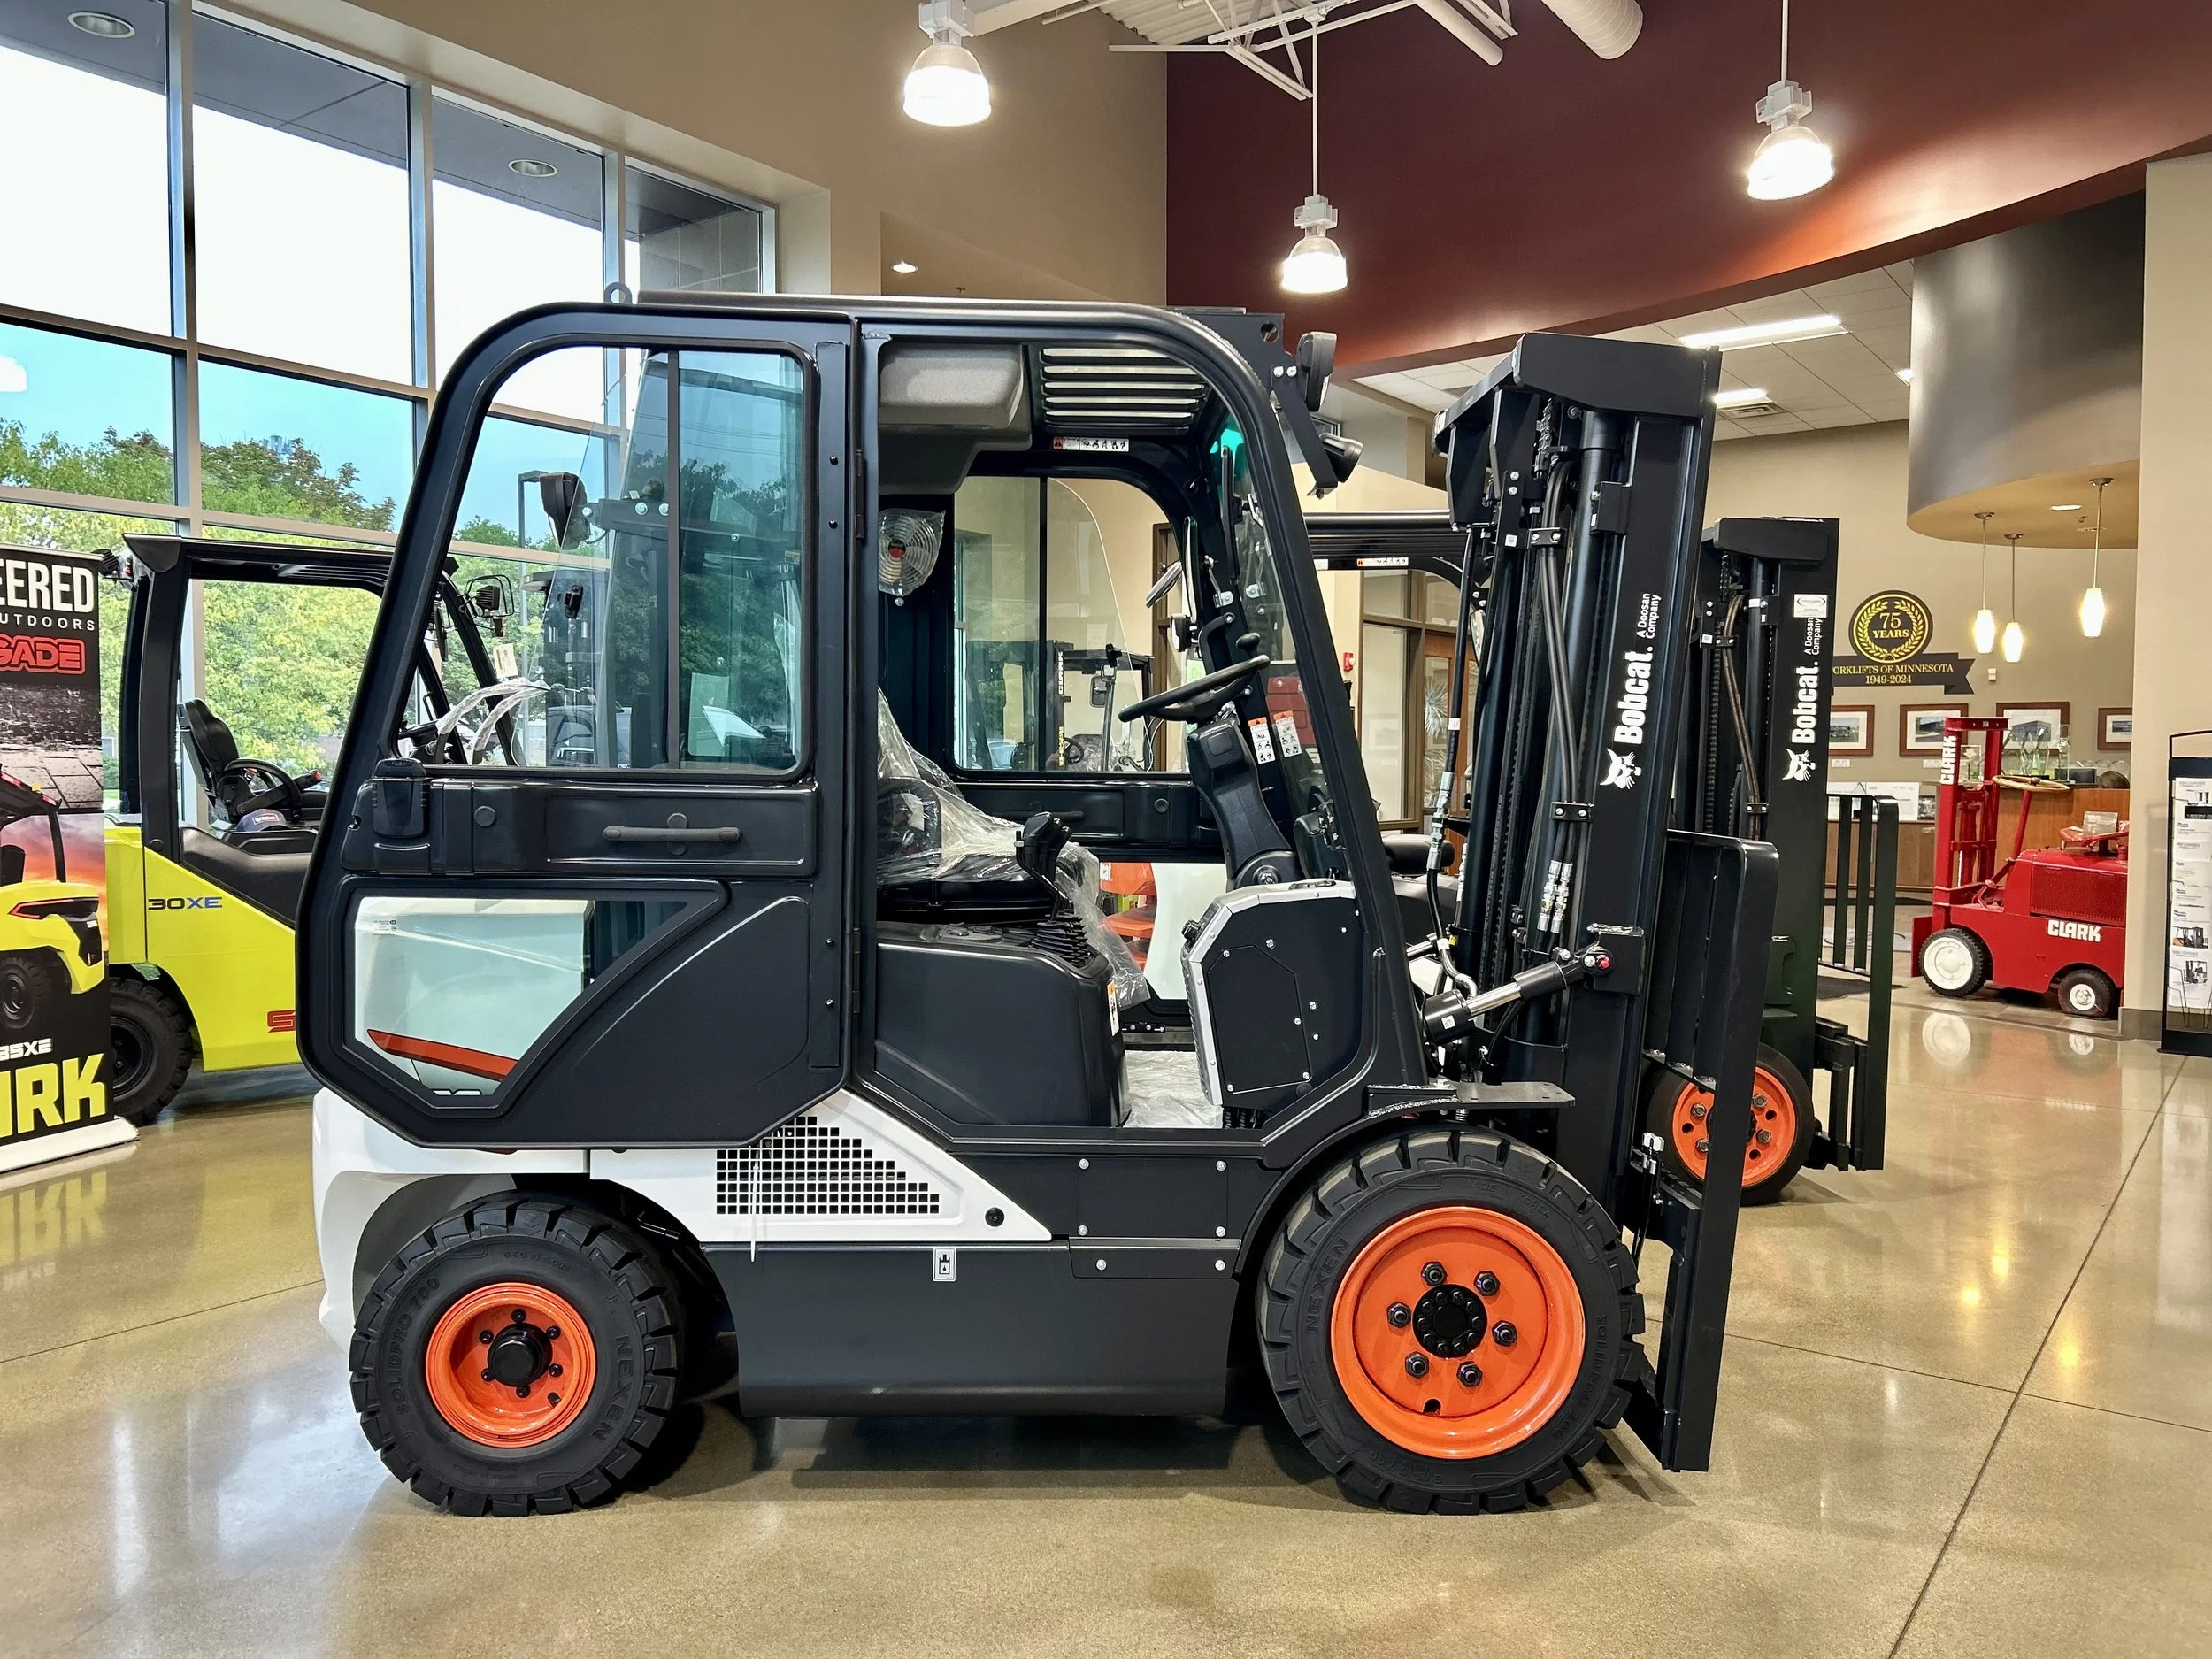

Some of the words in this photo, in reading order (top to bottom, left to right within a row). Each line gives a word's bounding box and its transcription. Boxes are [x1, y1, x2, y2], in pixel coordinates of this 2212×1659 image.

[0, 558, 95, 613] ERED
[1637, 593, 1652, 628] Doosan
[1645, 594, 1662, 640] Company
[1879, 612, 1901, 629] 75
[1636, 630, 1647, 639] A
[1804, 618, 1814, 647] Doosan
[1811, 618, 1824, 656] Company
[1872, 629, 1910, 639] YEARS
[1832, 665, 1878, 675] ORKLIFTS
[1880, 665, 1894, 674] OF
[1895, 664, 1955, 673] MINNESOTA
[1865, 674, 1912, 685] 1949-2024
[1940, 735, 1956, 785] CLARK
[147, 896, 223, 910] 30XE
[2047, 918, 2101, 942] CLARK
[1304, 1236, 1350, 1334] NEXEN
[388, 1313, 413, 1416] SOLIDPRO
[409, 1276, 441, 1313] 700
[1578, 1312, 1609, 1409] SOLIDPRO
[591, 1333, 634, 1444] NEXEN
